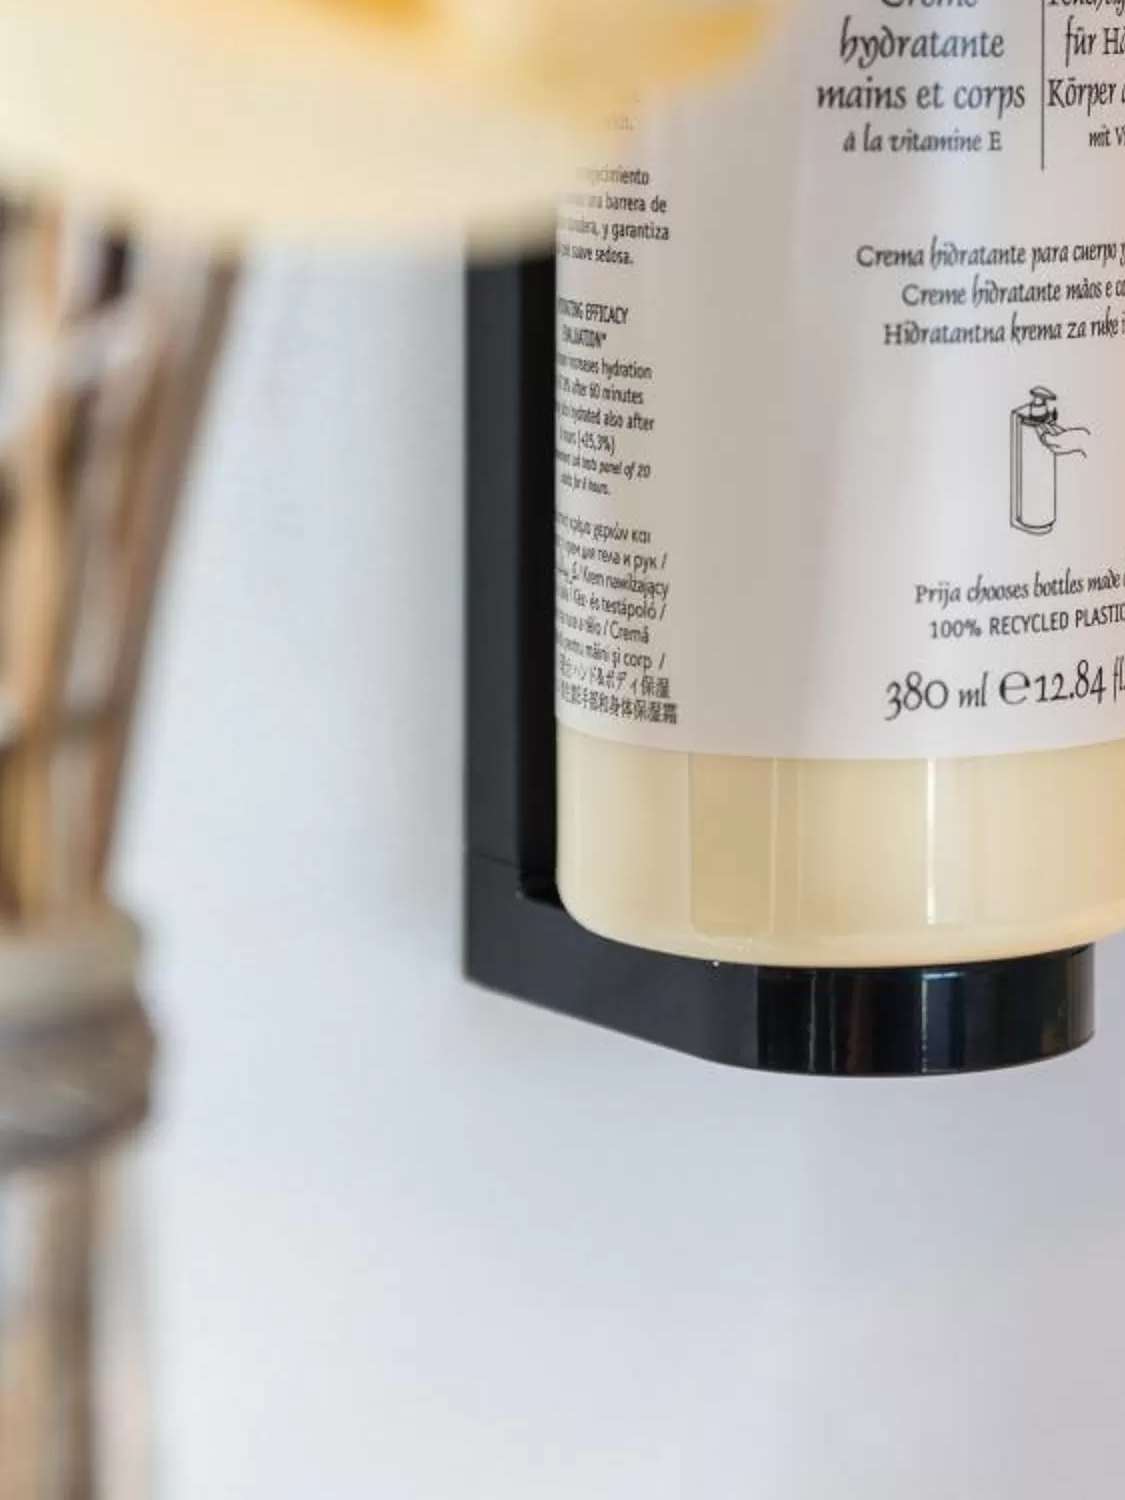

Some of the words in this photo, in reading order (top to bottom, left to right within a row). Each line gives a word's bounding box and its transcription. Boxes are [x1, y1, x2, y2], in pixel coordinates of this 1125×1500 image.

[839, 15, 1005, 69] hydratante
[1065, 14, 1097, 68] für
[816, 76, 907, 110] mains
[916, 82, 944, 109] et
[953, 83, 1026, 119] corps
[1047, 77, 1117, 116] Körper
[862, 123, 883, 152] la
[888, 128, 982, 153] vitamine
[988, 130, 1003, 152] E
[1089, 124, 1111, 147] mit
[651, 195, 668, 213] de
[612, 221, 670, 242] garantiza
[856, 244, 924, 268] Crema
[929, 234, 1026, 270] hidratante
[1031, 243, 1069, 272] para
[1073, 242, 1117, 268] cuerpo
[901, 283, 967, 307] Creme
[971, 273, 1062, 308] hidratante
[1105, 280, 1113, 298] e
[883, 319, 1006, 346] Hidratantna
[1010, 310, 1062, 346] krema
[1066, 321, 1087, 340] za
[1090, 305, 1119, 338] ruke
[1121, 311, 1125, 335] i
[601, 357, 653, 380] hydration
[602, 383, 645, 405] minutes
[626, 411, 655, 431] after
[637, 463, 652, 479] 20
[914, 581, 961, 610] Prija
[966, 573, 1030, 604] chooses
[1033, 567, 1084, 598] bottles
[1087, 564, 1121, 592] made
[929, 618, 982, 639] 100%
[989, 611, 1069, 636] RECYCLED
[623, 652, 653, 677] corp
[884, 670, 950, 721] 380
[958, 670, 989, 708] ml
[1034, 658, 1107, 705] 12.84
